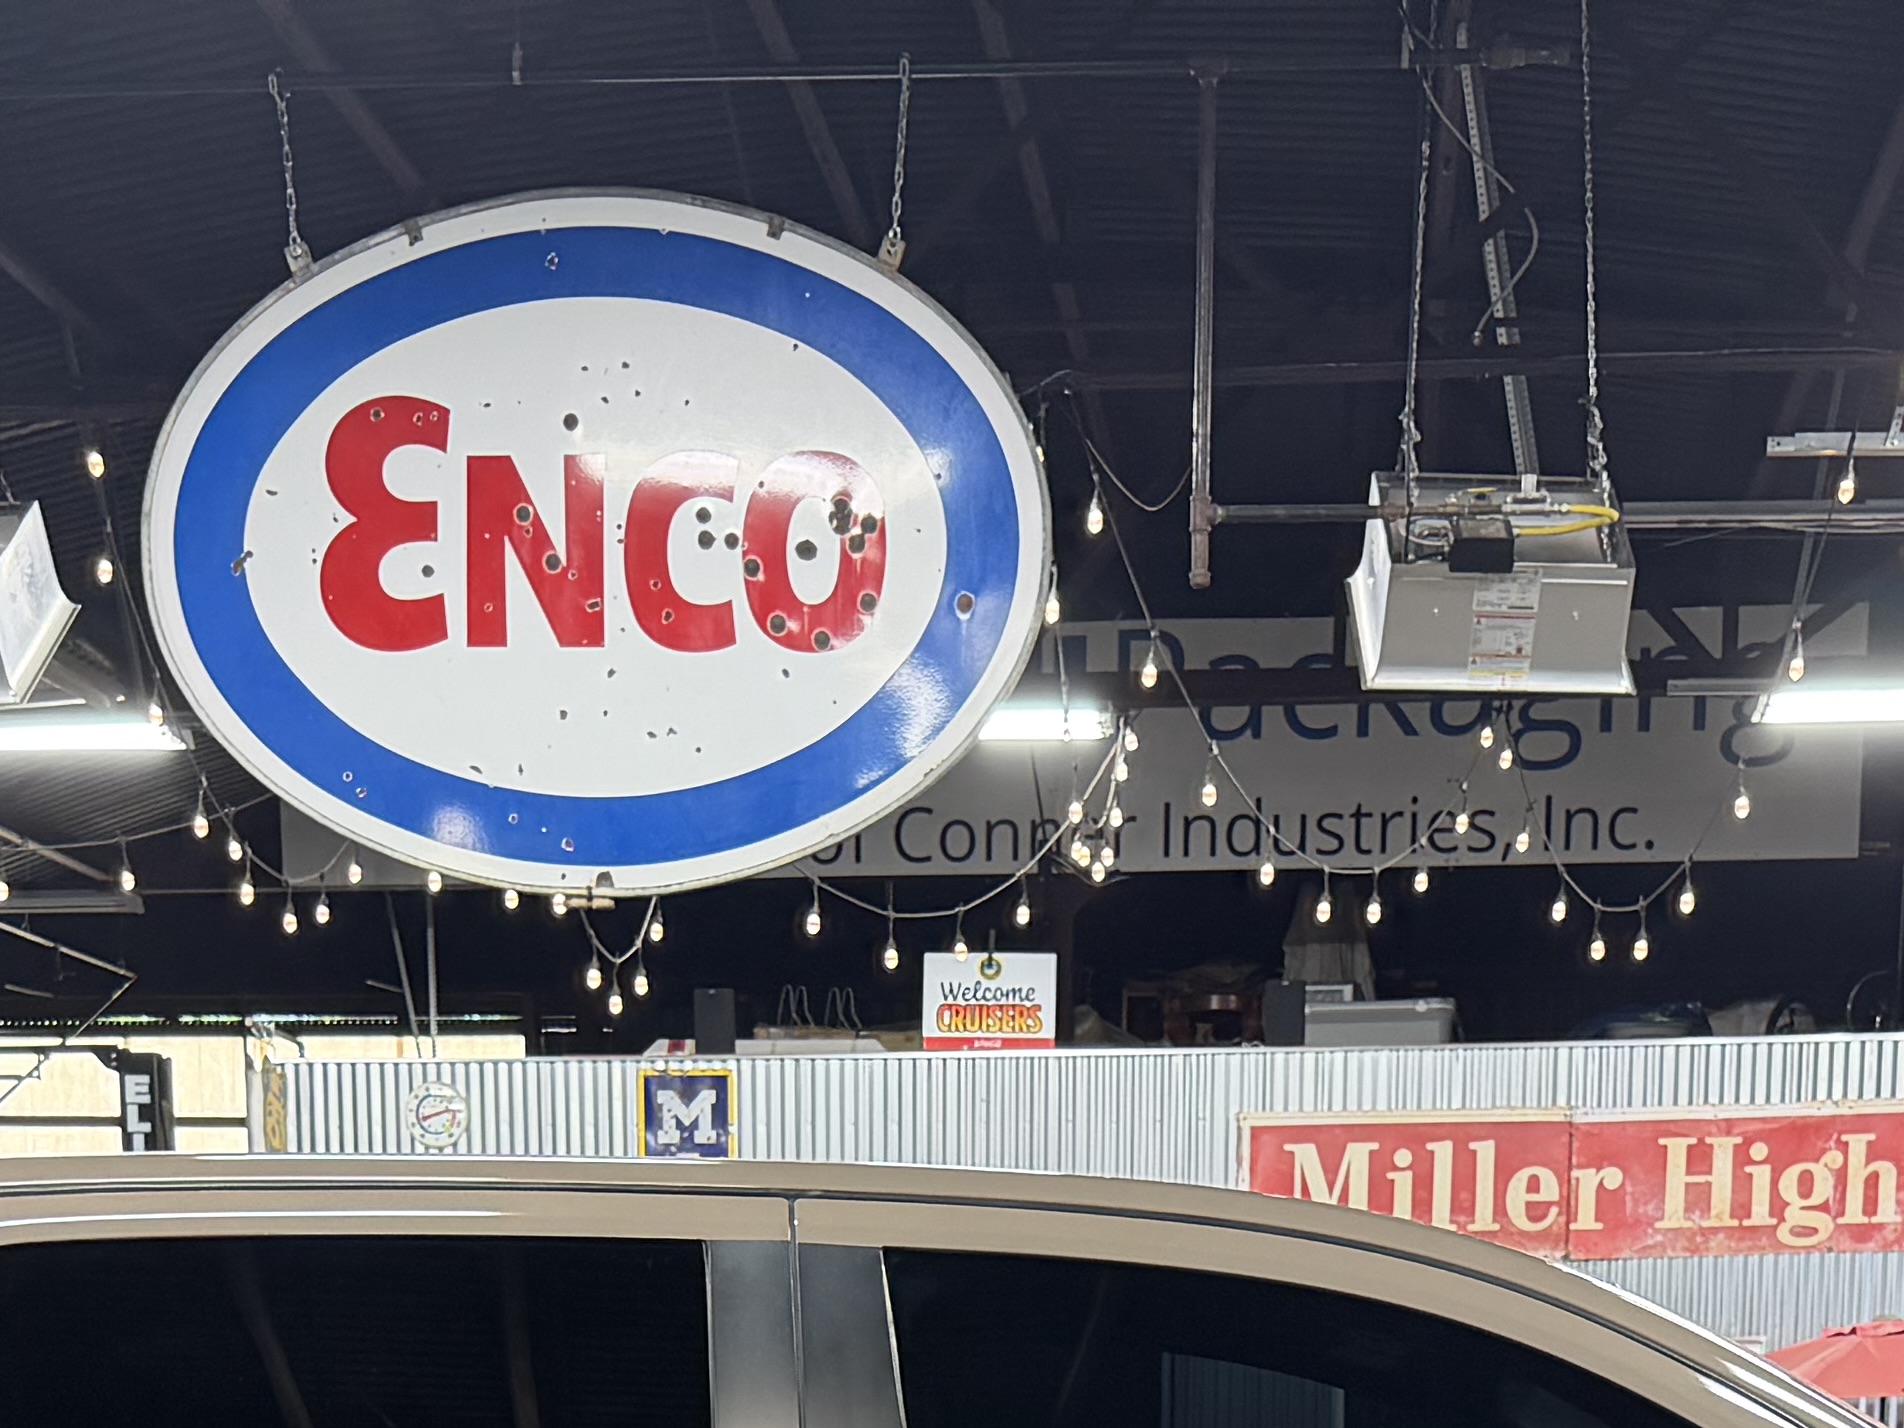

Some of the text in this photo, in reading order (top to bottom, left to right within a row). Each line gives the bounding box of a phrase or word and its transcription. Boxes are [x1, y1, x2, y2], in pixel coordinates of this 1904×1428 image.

[318, 395, 887, 653] ENCO
[1119, 630, 1793, 771] Pacgng
[1161, 796, 1510, 861] Industries,
[1542, 796, 1655, 852] Inc.
[937, 1003, 1043, 1033] CRUISERS
[941, 981, 1036, 1002] Welcome
[657, 1090, 717, 1144] M
[1285, 1137, 1623, 1234] Miller
[1657, 1131, 1900, 1247] High
